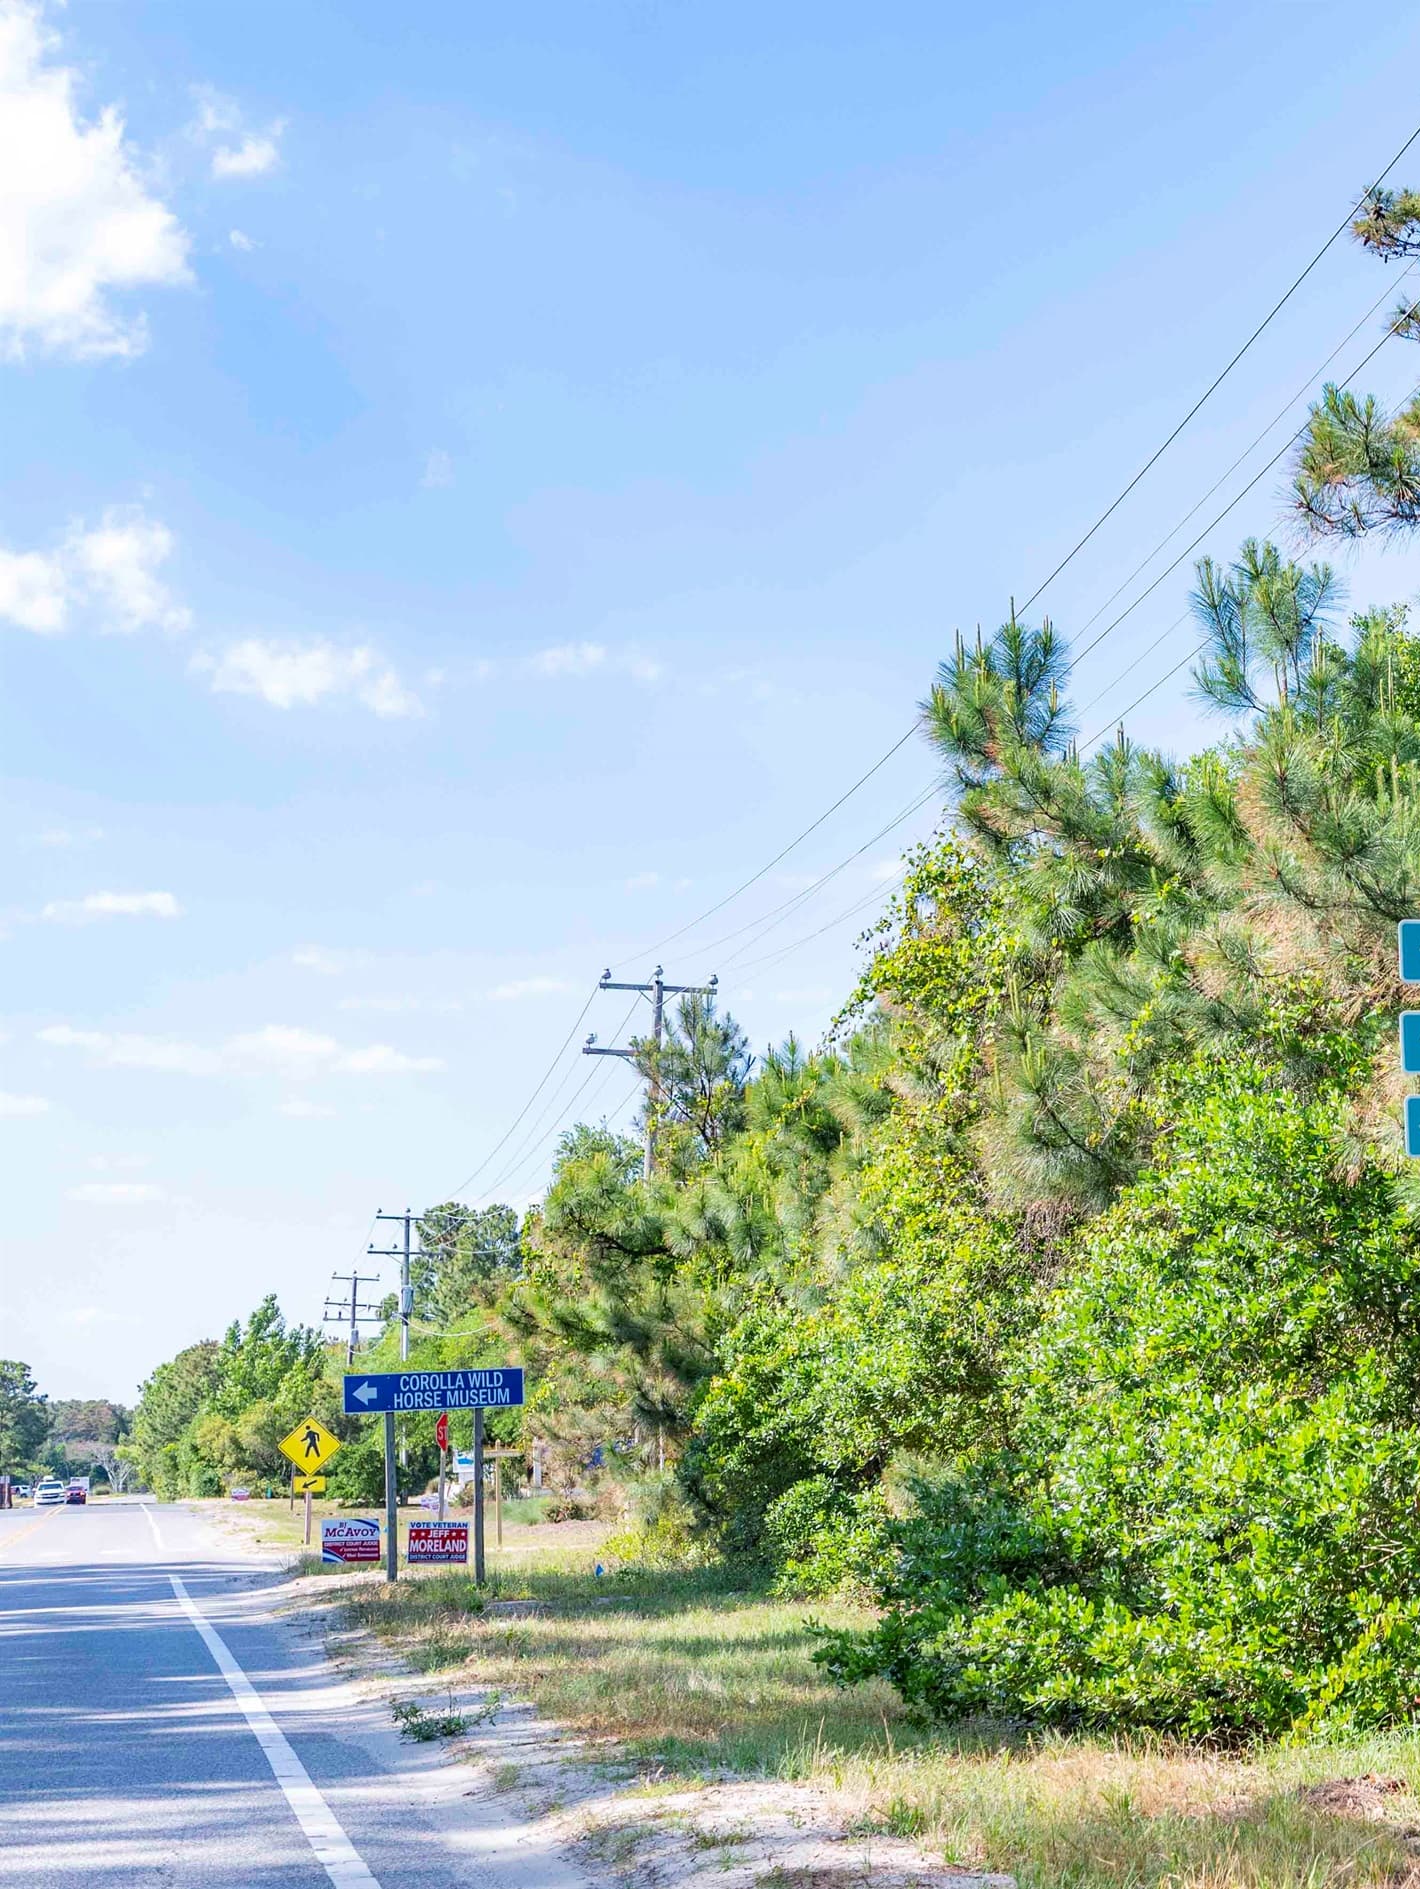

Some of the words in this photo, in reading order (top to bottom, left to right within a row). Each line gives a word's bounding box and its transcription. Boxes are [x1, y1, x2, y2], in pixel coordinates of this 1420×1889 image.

[400, 1373, 464, 1391] COROLLA
[468, 1371, 503, 1388] WILD
[393, 1391, 442, 1409] HORSE
[447, 1388, 510, 1406] MUSEUM
[428, 1530, 450, 1538] JEFF
[410, 1539, 466, 1552] MORELAND
